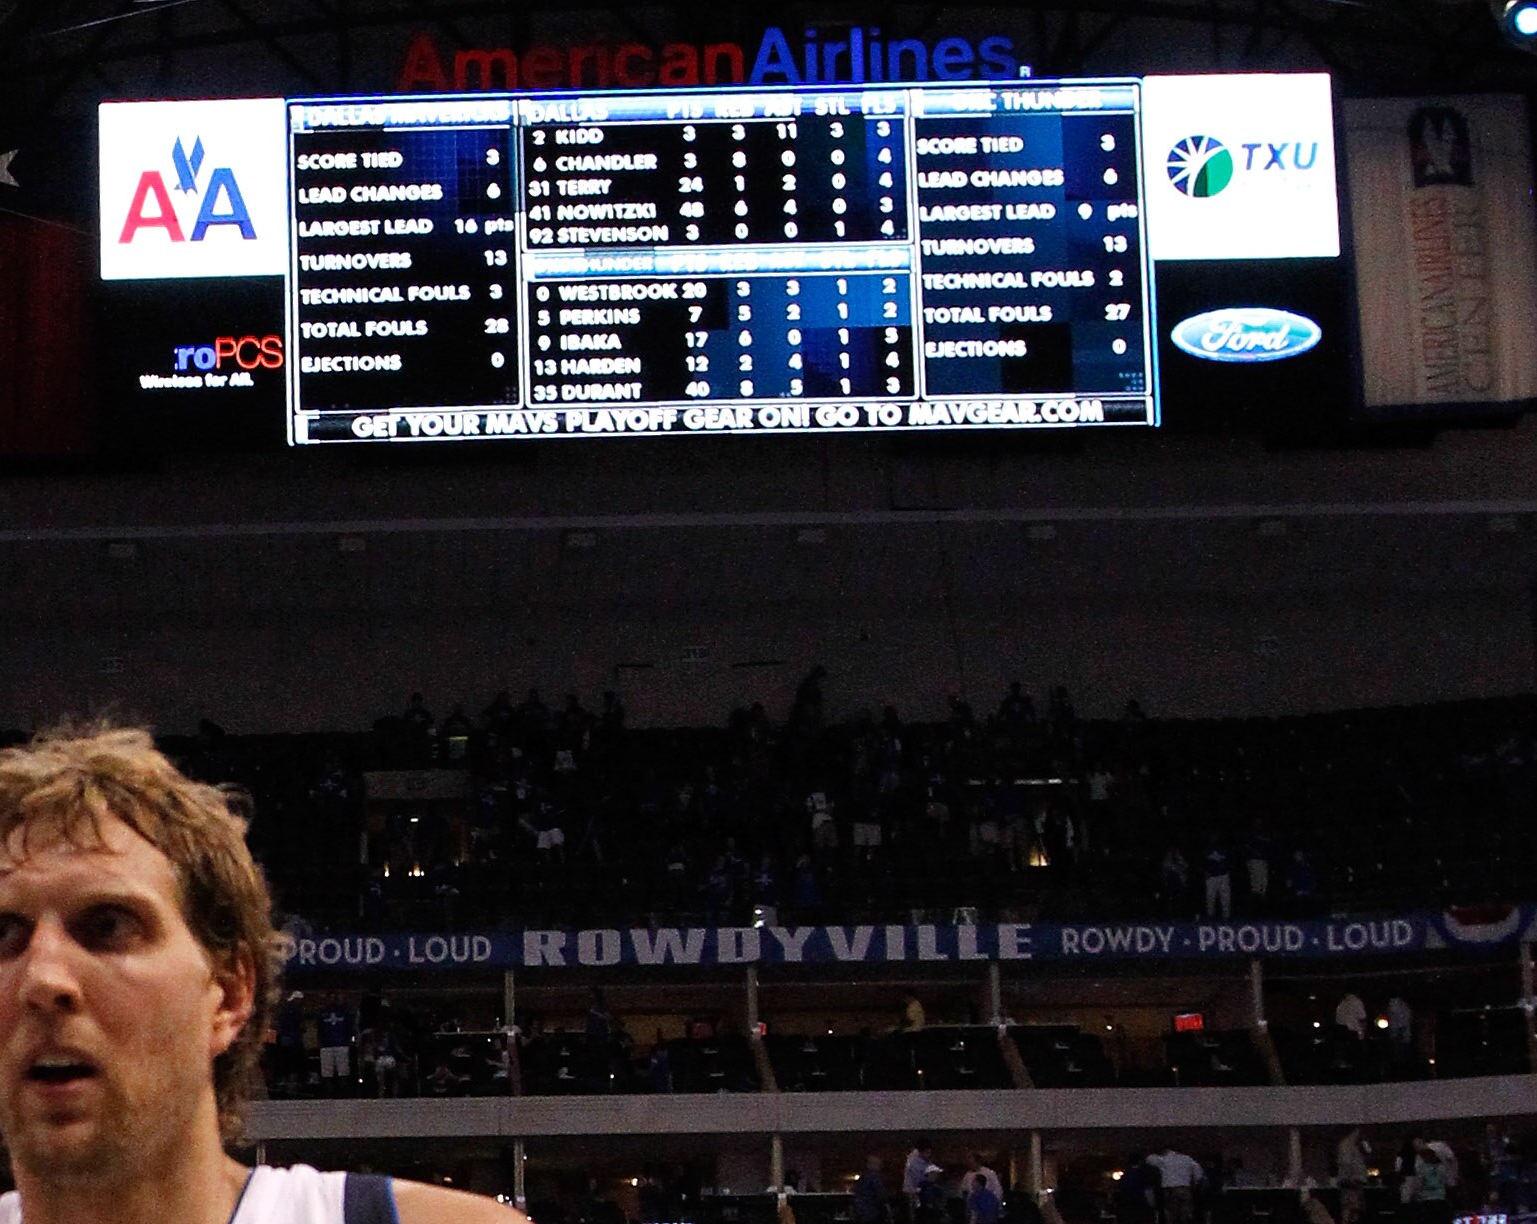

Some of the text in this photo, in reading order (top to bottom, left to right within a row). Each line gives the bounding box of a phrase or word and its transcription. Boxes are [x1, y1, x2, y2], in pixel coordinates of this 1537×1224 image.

[529, 102, 609, 124] DALLAS
[814, 97, 850, 116] STL
[532, 125, 746, 145] 2 KIDD 3 3
[917, 134, 1116, 155] SCORE TIED 3
[297, 149, 500, 170] SCORE TIED 3
[533, 153, 697, 172] 6 CHANDLER 3
[1241, 141, 1318, 171] TXU
[528, 177, 704, 197] 31 TERRY 24
[918, 171, 968, 189] LEAD
[970, 168, 1064, 187] CHANGES
[298, 183, 501, 204] LEAD CHANGES 6
[529, 205, 551, 221] 41
[557, 204, 656, 220] NOWITZKI
[679, 203, 705, 218] 48
[919, 205, 1003, 222] LARGEST
[1005, 203, 1056, 220] LEAD
[1107, 202, 1138, 222] pts
[298, 217, 515, 238] LARGEST LEAD 16 pts
[529, 225, 700, 245] 92 STEVENSON 3
[921, 235, 1127, 257] TURNOVERS 13
[299, 252, 412, 271] TURNOVERS
[484, 250, 508, 267] 13
[922, 270, 1123, 291] TECHNICAL FOULS 2
[300, 284, 503, 305] TECHNICAL FOULS 3
[536, 282, 707, 302] 0 WESTBROOK 20
[538, 307, 703, 326] 5 PERKINS 7
[923, 304, 1131, 323] TOTAL FOULS 27
[301, 318, 510, 339] TOTAL FOULS 28
[1200, 318, 1289, 353] Ford
[560, 333, 622, 351] IBAKA
[685, 332, 709, 348] 17
[924, 339, 1126, 359] EJECTIONS 0
[301, 352, 504, 373] EJECTIONS 0
[534, 356, 709, 376] 13 HARDEN 12
[534, 381, 710, 401] 35 DURANT 40
[351, 416, 398, 438] GET
[404, 414, 480, 437] YOUR
[485, 412, 558, 435] MAVS
[565, 408, 676, 434] PLAYOFF
[683, 407, 753, 431] GEAR
[816, 405, 860, 428] GO
[865, 404, 904, 426] TO
[908, 400, 1104, 427] MAVGEAR.COM
[523, 923, 1032, 967] ROWDYVILLE
[1062, 920, 1413, 955] ROWDY PROUD LOUD
[280, 935, 492, 966] PROUD LOUD
